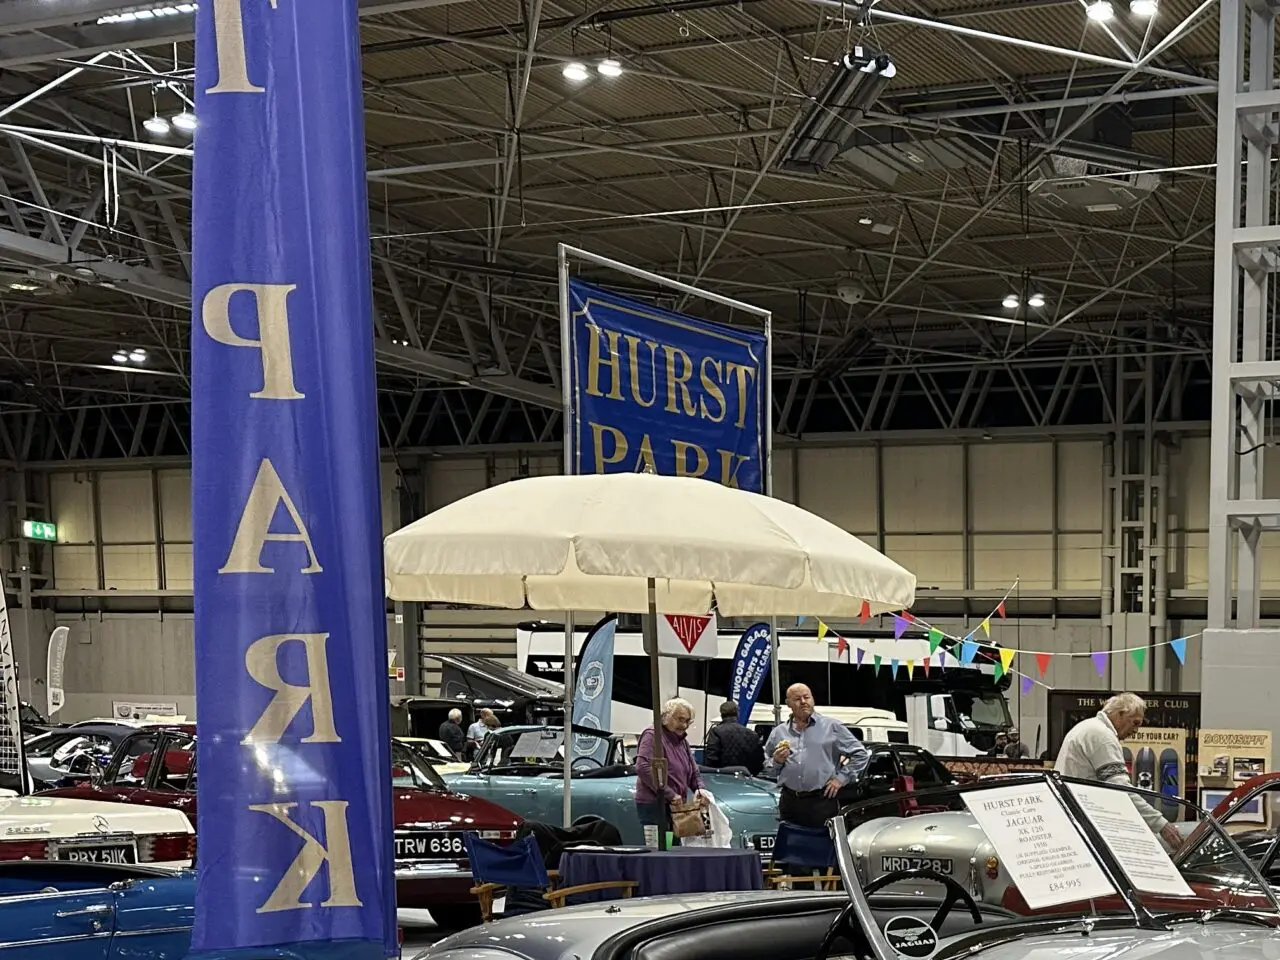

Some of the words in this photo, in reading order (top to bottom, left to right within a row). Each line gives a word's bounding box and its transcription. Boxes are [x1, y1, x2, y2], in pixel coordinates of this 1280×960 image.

[585, 323, 756, 429] HURST
[588, 421, 751, 488] PARK
[673, 616, 702, 648] ALVIS
[741, 657, 758, 689] SPORTS
[754, 648, 762, 657] &
[745, 667, 764, 700] CLASSIC
[1077, 698, 1096, 707] THE
[1164, 700, 1190, 708] CLUB
[1137, 732, 1145, 740] OF
[1146, 732, 1163, 740] YOUR
[1163, 733, 1179, 741] CAR?
[983, 799, 1016, 812] HURST
[1018, 795, 1043, 806] PARK
[1006, 814, 1045, 828] JAGUAR
[1018, 828, 1030, 836] XK
[1032, 826, 1044, 834] 120
[1018, 832, 1053, 843] ROADSTER
[394, 838, 426, 854] TRW
[430, 837, 468, 853] 636
[760, 836, 777, 849] ED
[882, 857, 910, 871] MRD
[912, 859, 953, 874] 728J
[895, 938, 936, 948] JAGUAR
